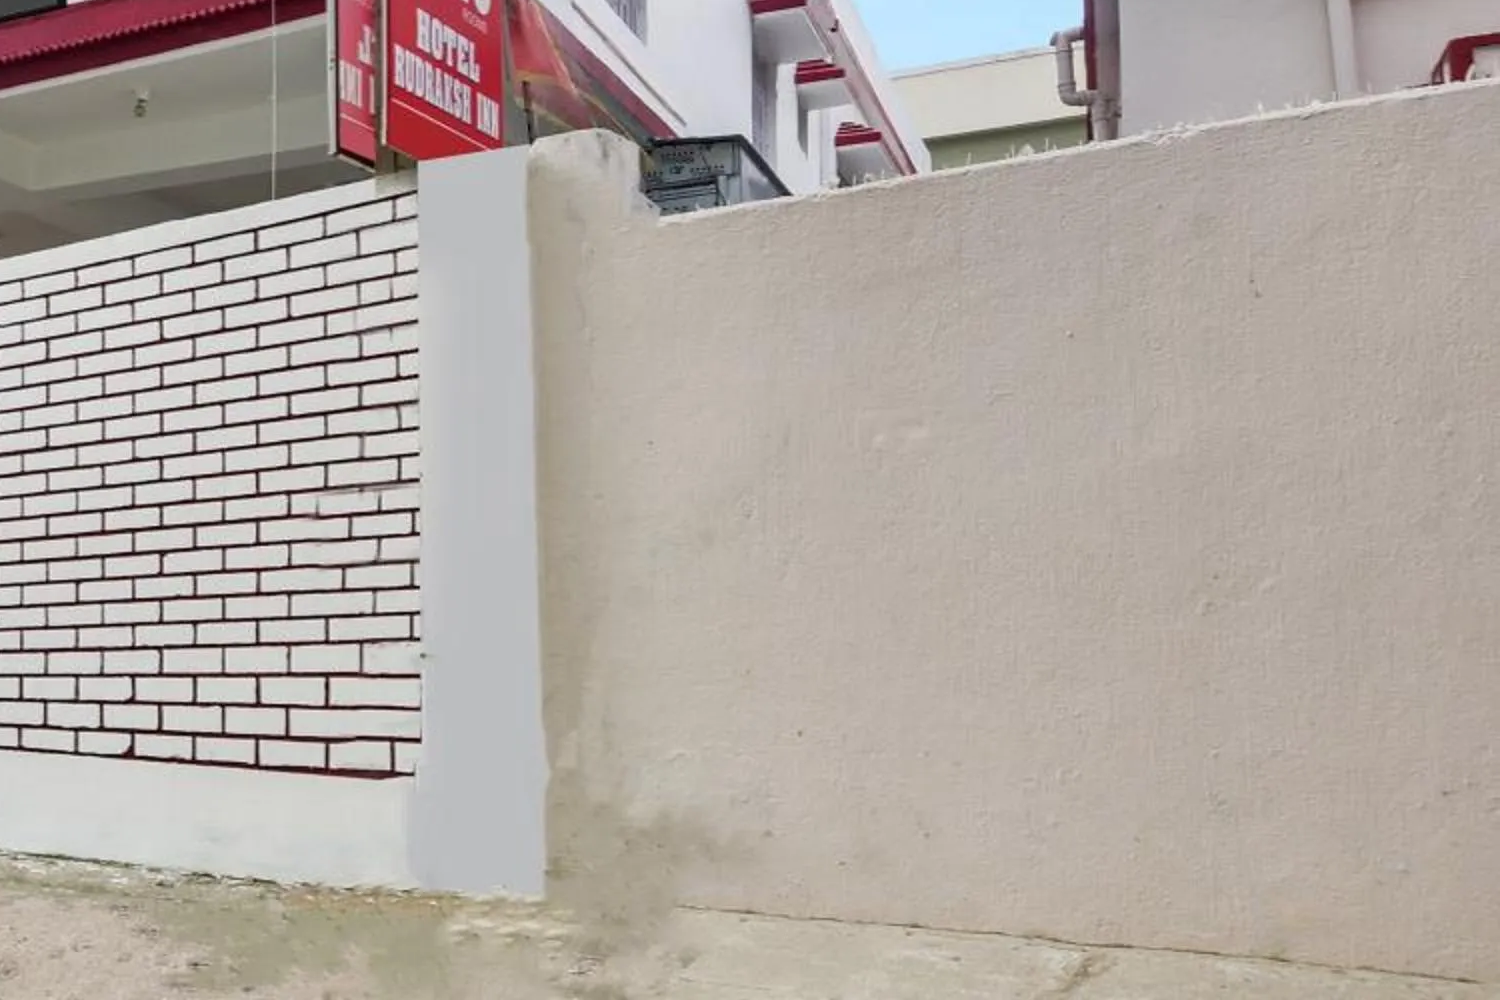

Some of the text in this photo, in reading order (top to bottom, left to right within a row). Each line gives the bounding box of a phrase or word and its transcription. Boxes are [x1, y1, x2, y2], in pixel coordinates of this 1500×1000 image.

[416, 7, 480, 83] HOTEL
[393, 43, 472, 125] RUDRAKSH
[476, 92, 500, 140] INN
